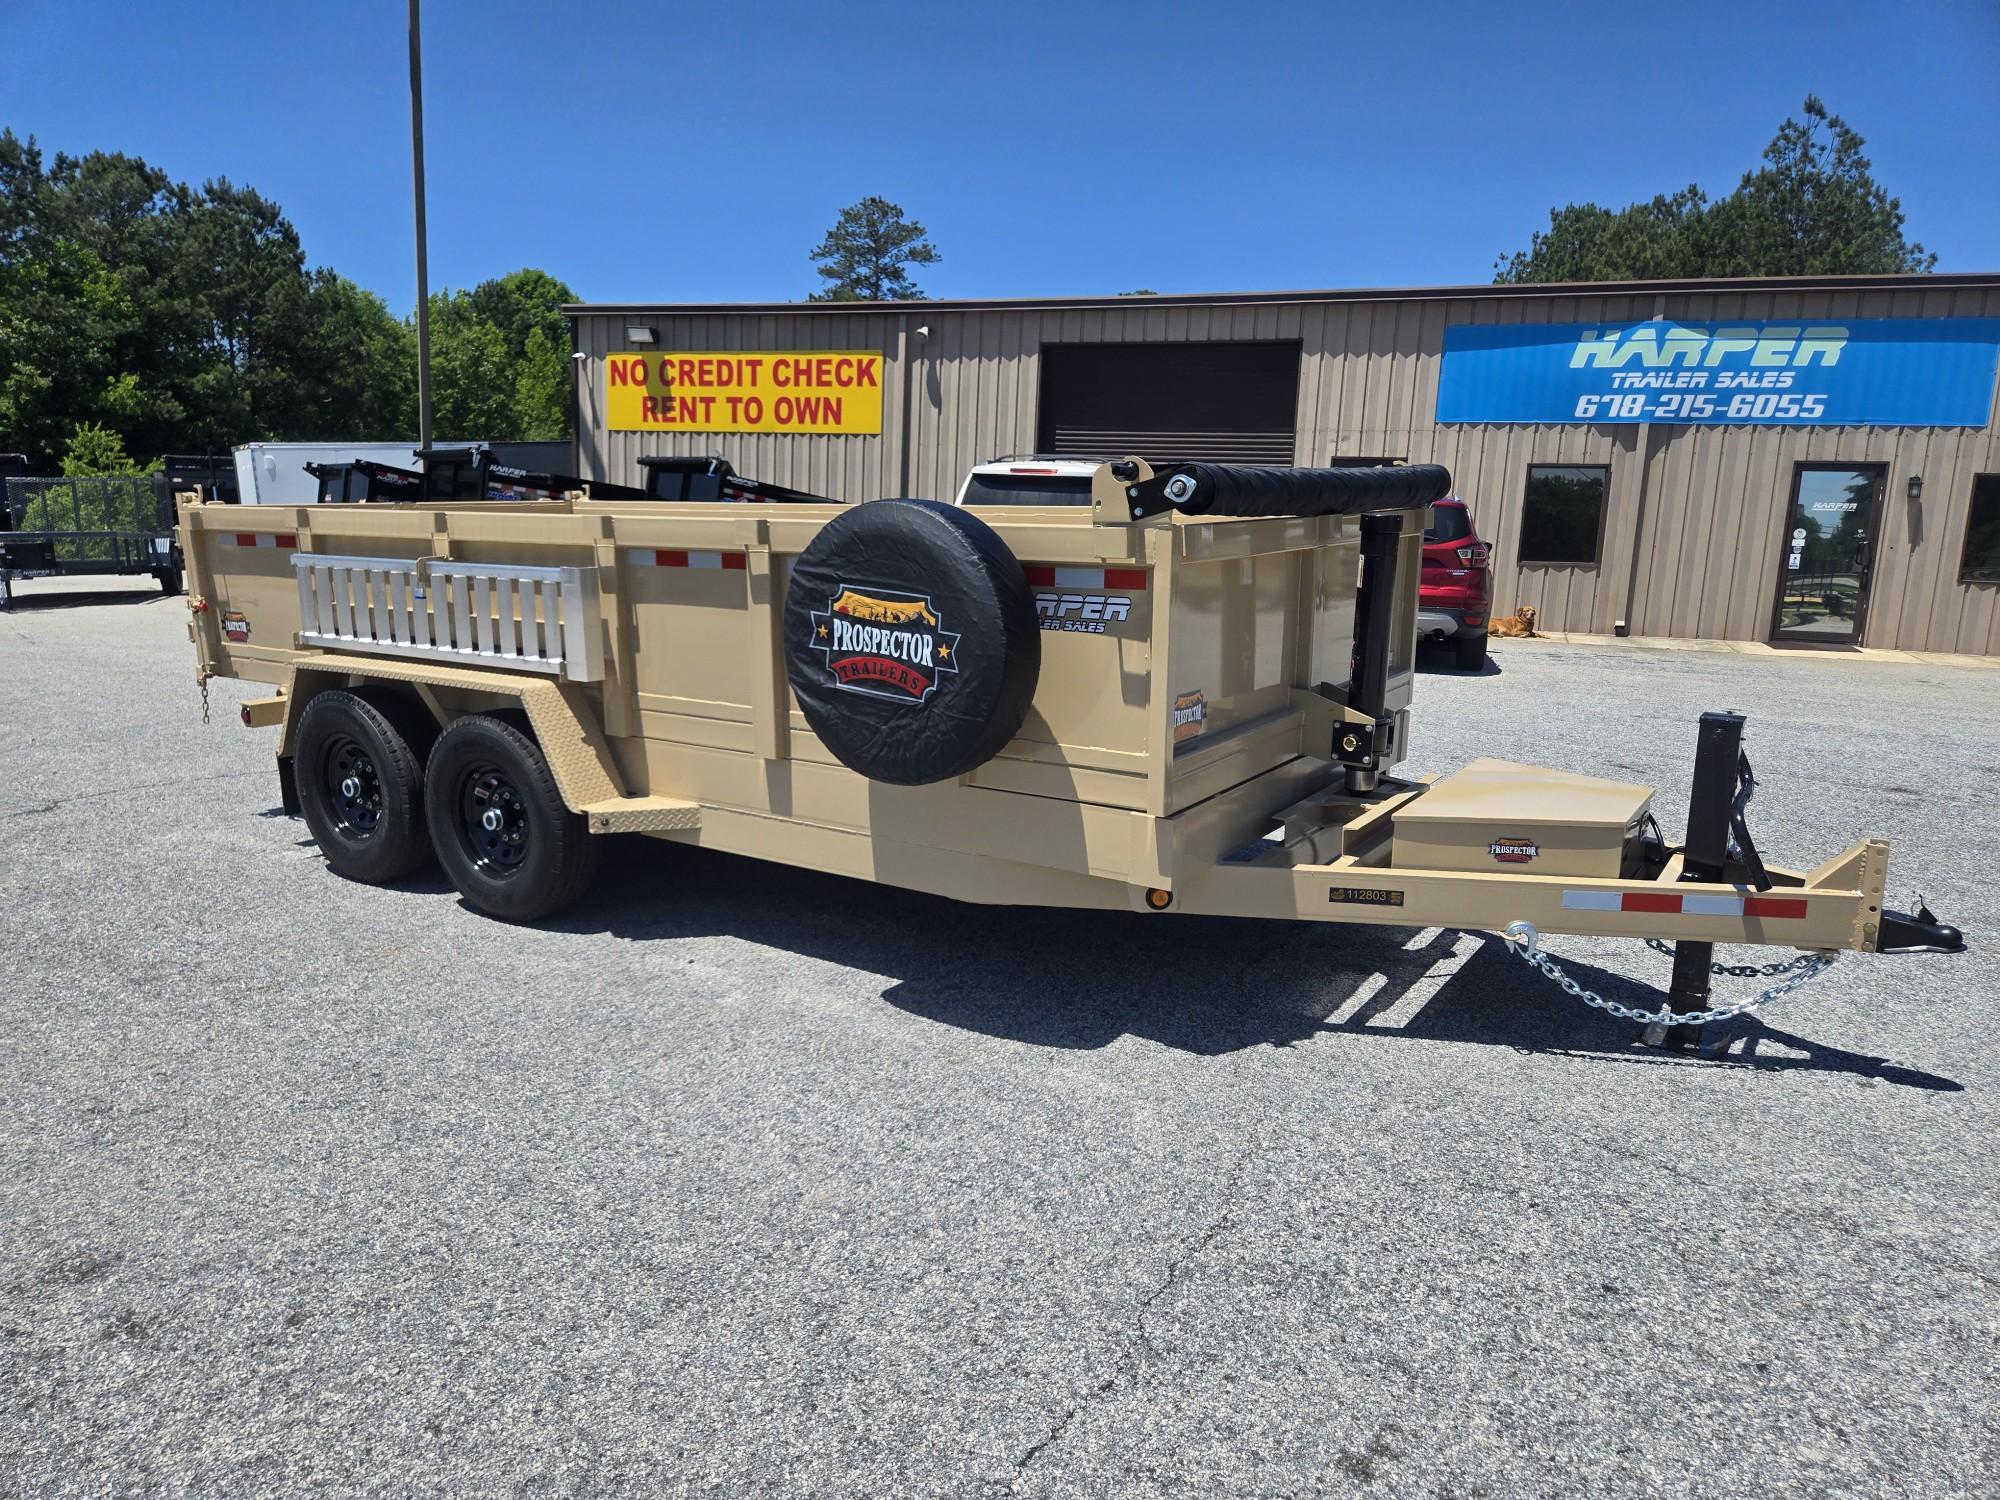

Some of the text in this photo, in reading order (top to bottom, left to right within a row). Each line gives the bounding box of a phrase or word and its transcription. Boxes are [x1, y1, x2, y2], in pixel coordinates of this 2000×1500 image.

[1569, 326, 1850, 368] HARPER
[610, 358, 878, 388] NO CREDIT CHECK
[1611, 371, 1796, 389] TRAILER SALES
[641, 396, 843, 426] RENT TO OWN
[1574, 393, 1828, 418] 678-215-6055
[1034, 592, 1132, 621] RPER
[1063, 620, 1106, 633] SALES
[832, 618, 934, 668] PROSPECTOR
[839, 661, 920, 690] TRAILERS
[1490, 844, 1537, 856] PROSPECTOR
[1347, 889, 1387, 901] 112803
